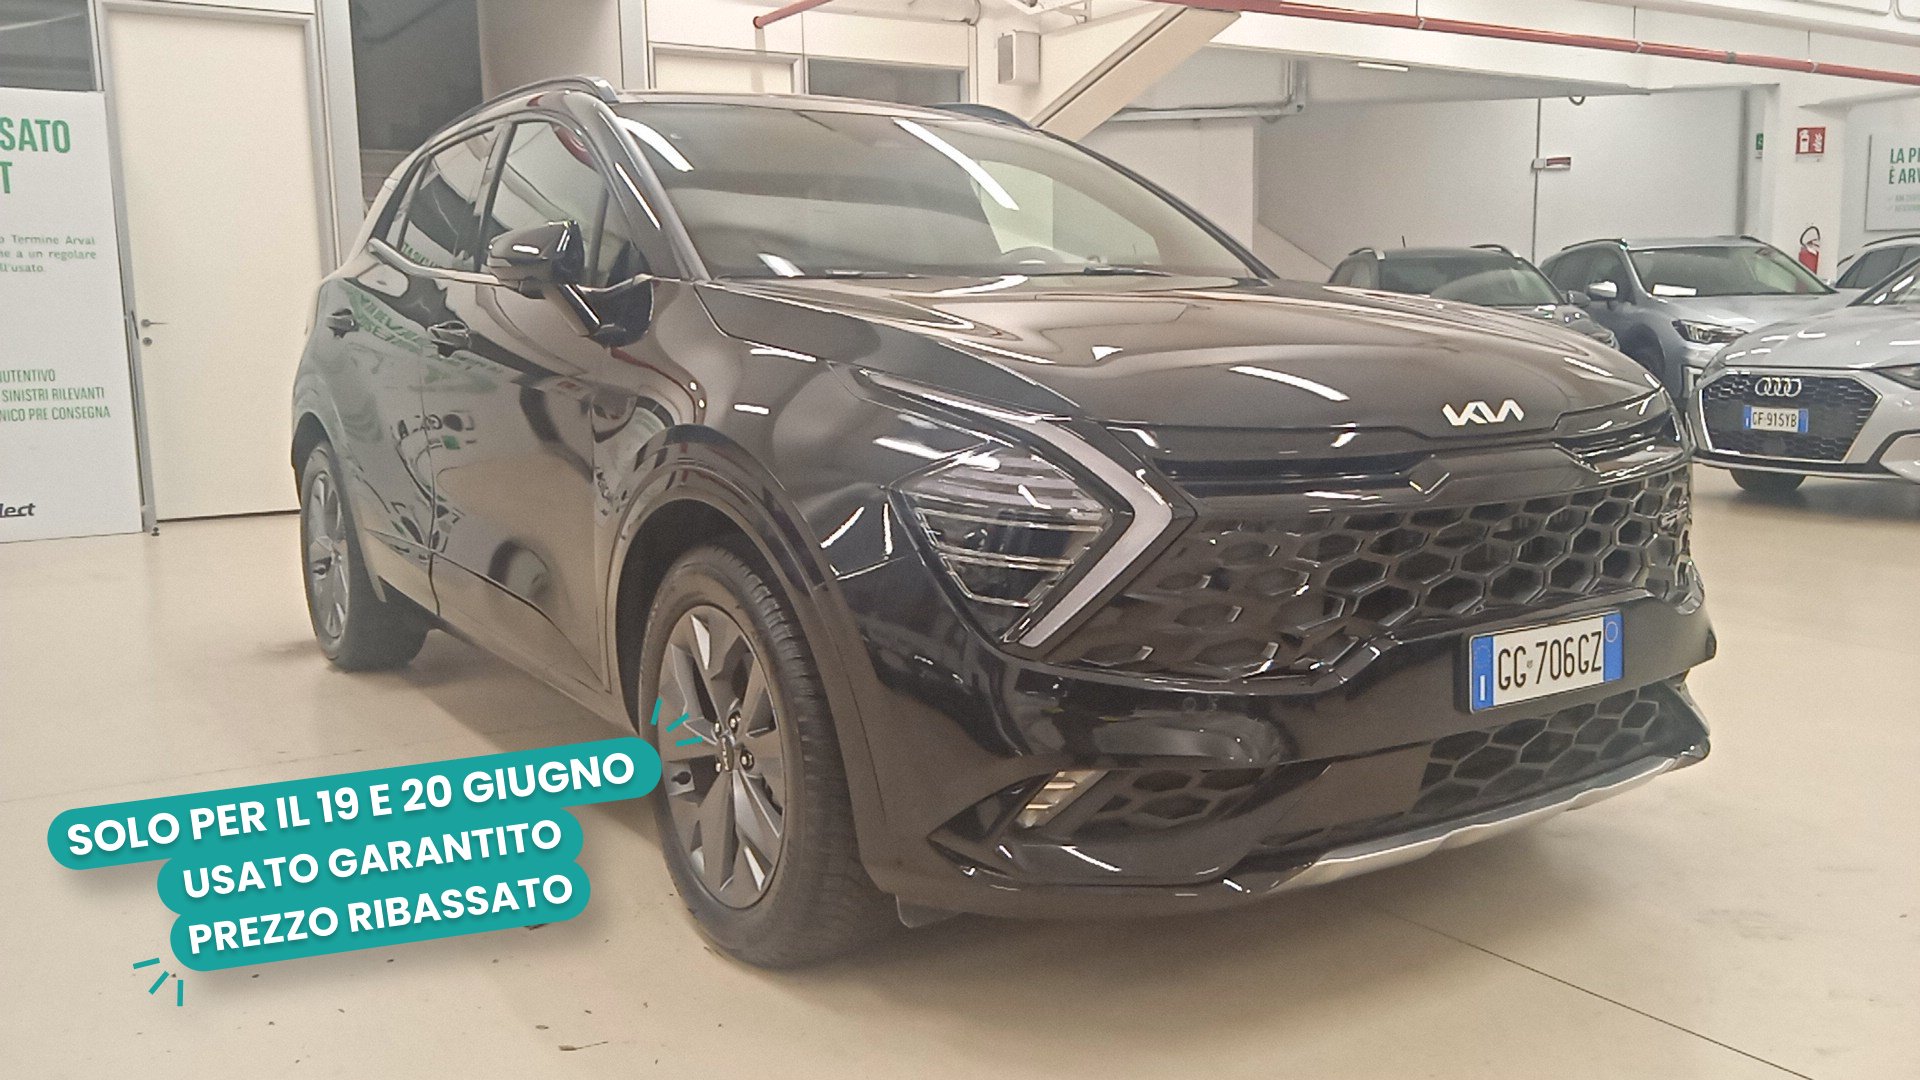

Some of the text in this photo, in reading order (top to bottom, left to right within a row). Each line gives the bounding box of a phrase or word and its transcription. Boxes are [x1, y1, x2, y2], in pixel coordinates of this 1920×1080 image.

[0, 117, 71, 153] SATO
[1890, 148, 1905, 164] LA
[11, 234, 59, 245] Termine
[65, 235, 96, 246] Arval
[48, 250, 96, 261] regolare
[2, 386, 105, 402] SINISTRI RILEVANTI
[28, 407, 48, 421] PRE
[51, 406, 111, 420] CONSEGNA
